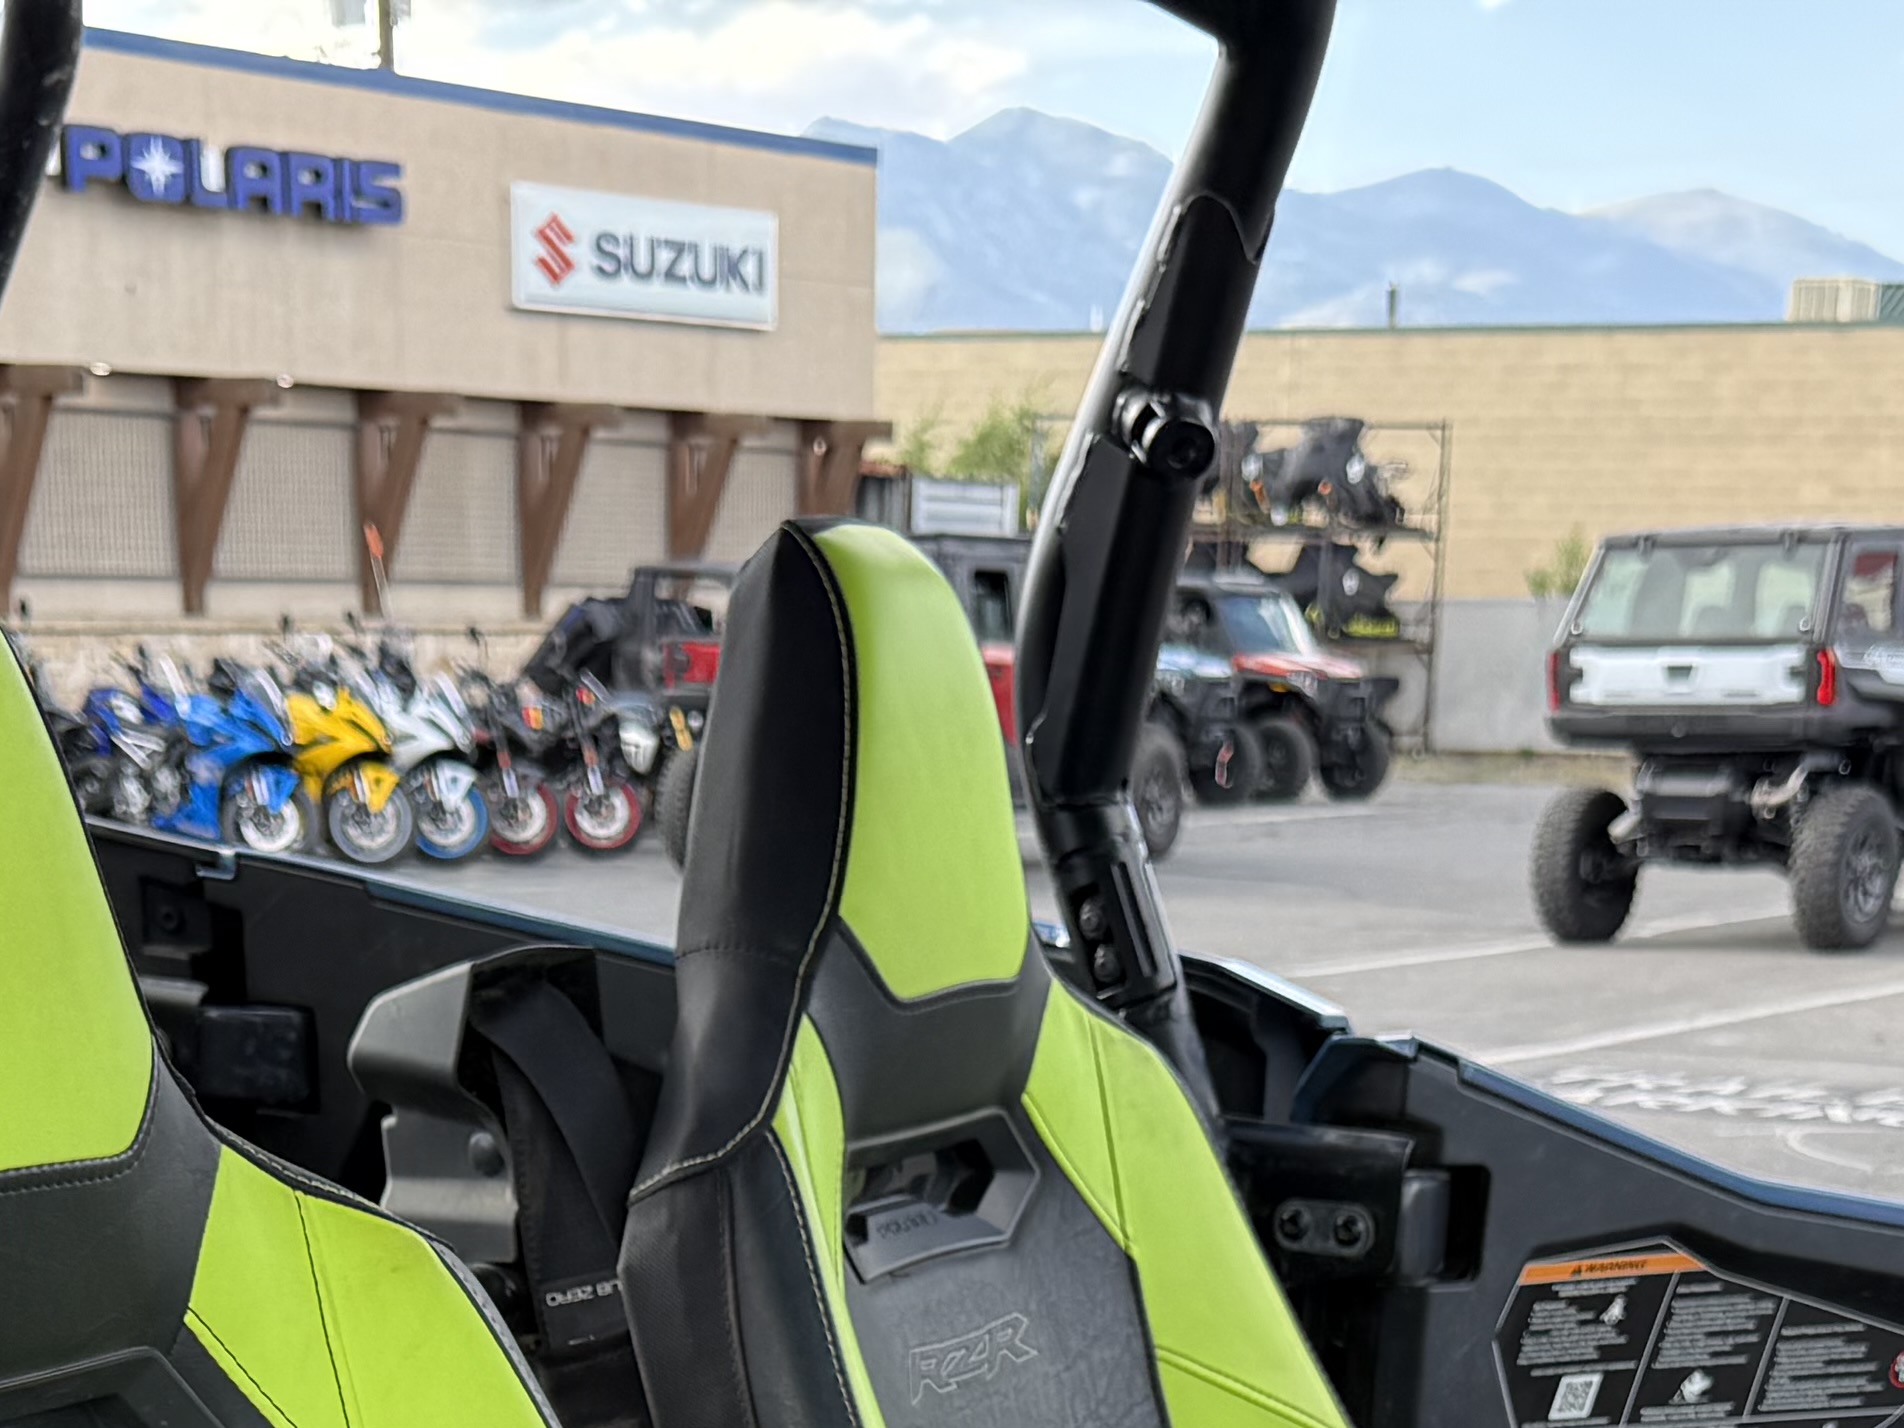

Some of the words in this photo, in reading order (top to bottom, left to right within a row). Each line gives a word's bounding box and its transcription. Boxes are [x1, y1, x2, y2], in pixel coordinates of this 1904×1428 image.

[61, 125, 406, 226] POLARIS
[594, 231, 765, 293] SUZUKI
[908, 1311, 1039, 1406] RZR
